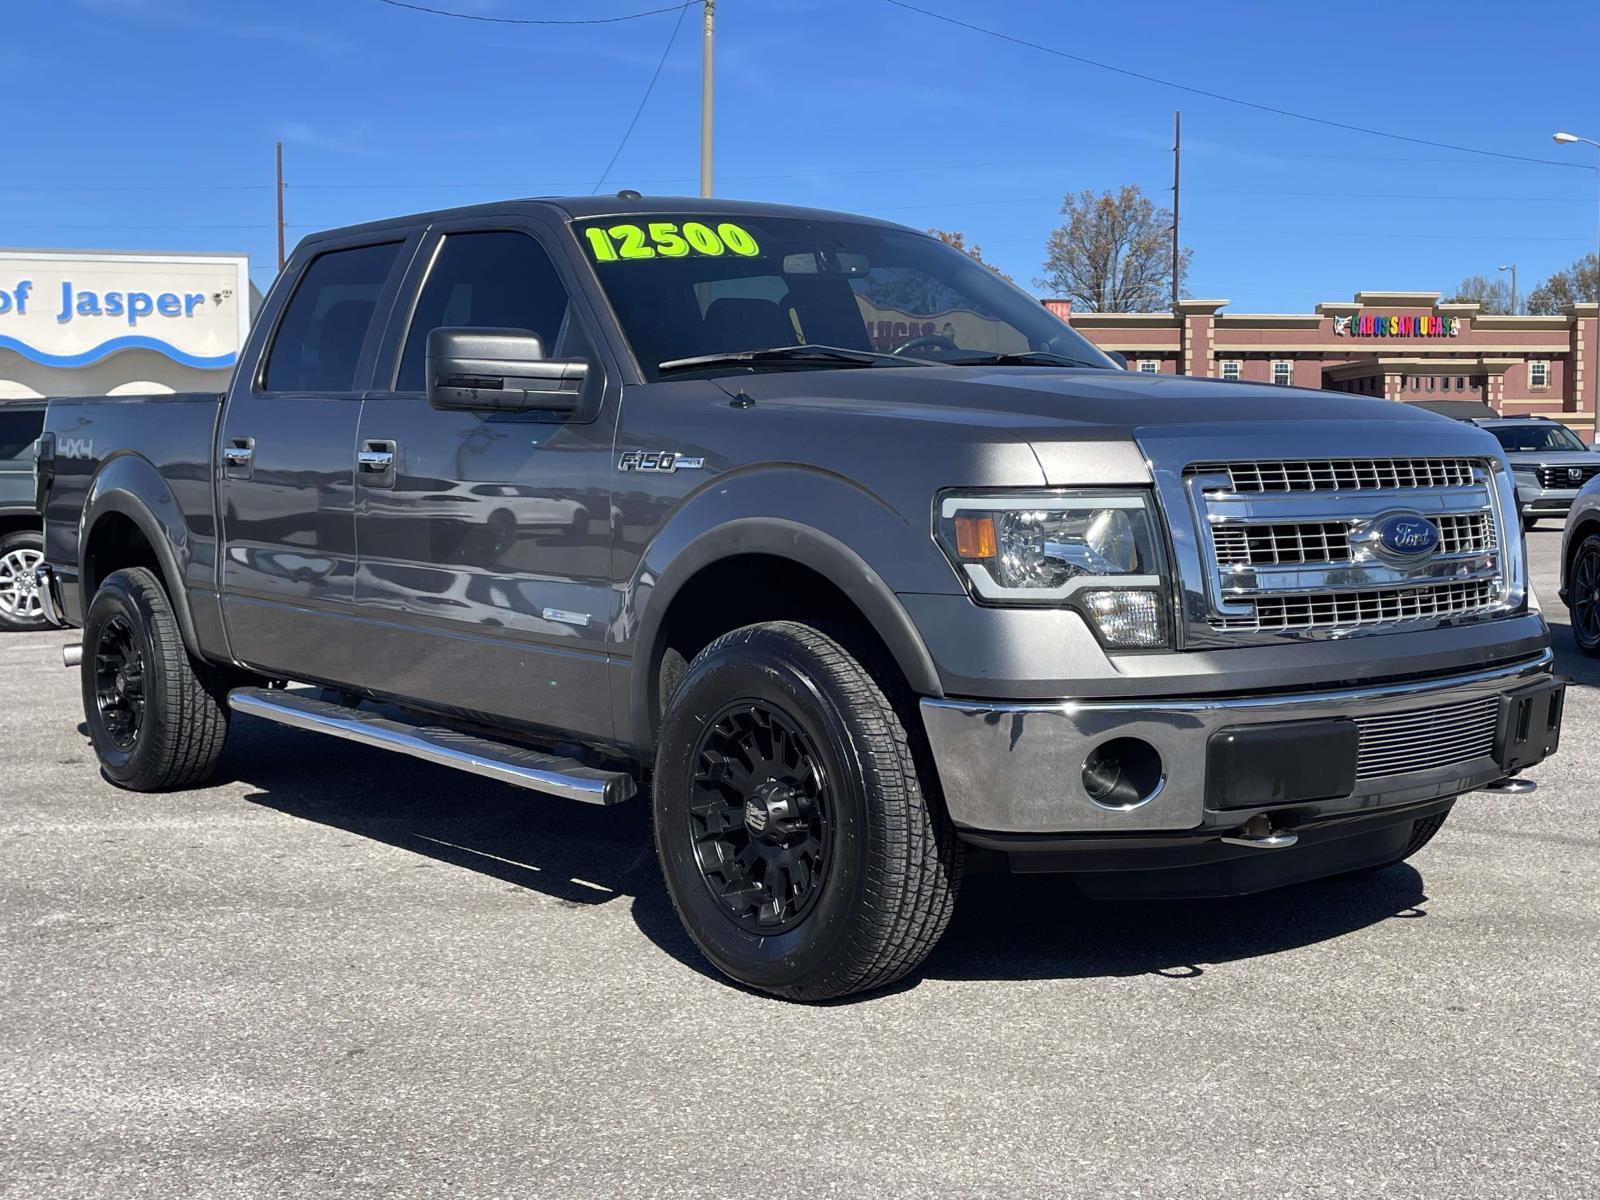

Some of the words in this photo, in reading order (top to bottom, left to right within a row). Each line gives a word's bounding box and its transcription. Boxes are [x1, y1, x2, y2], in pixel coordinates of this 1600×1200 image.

[585, 222, 760, 260] 12500
[56, 281, 205, 327] Jasper
[1350, 316, 1389, 335] CABOS
[1390, 316, 1413, 335] SAN
[1413, 316, 1450, 335] LUCAS
[1395, 522, 1431, 546] Ford
